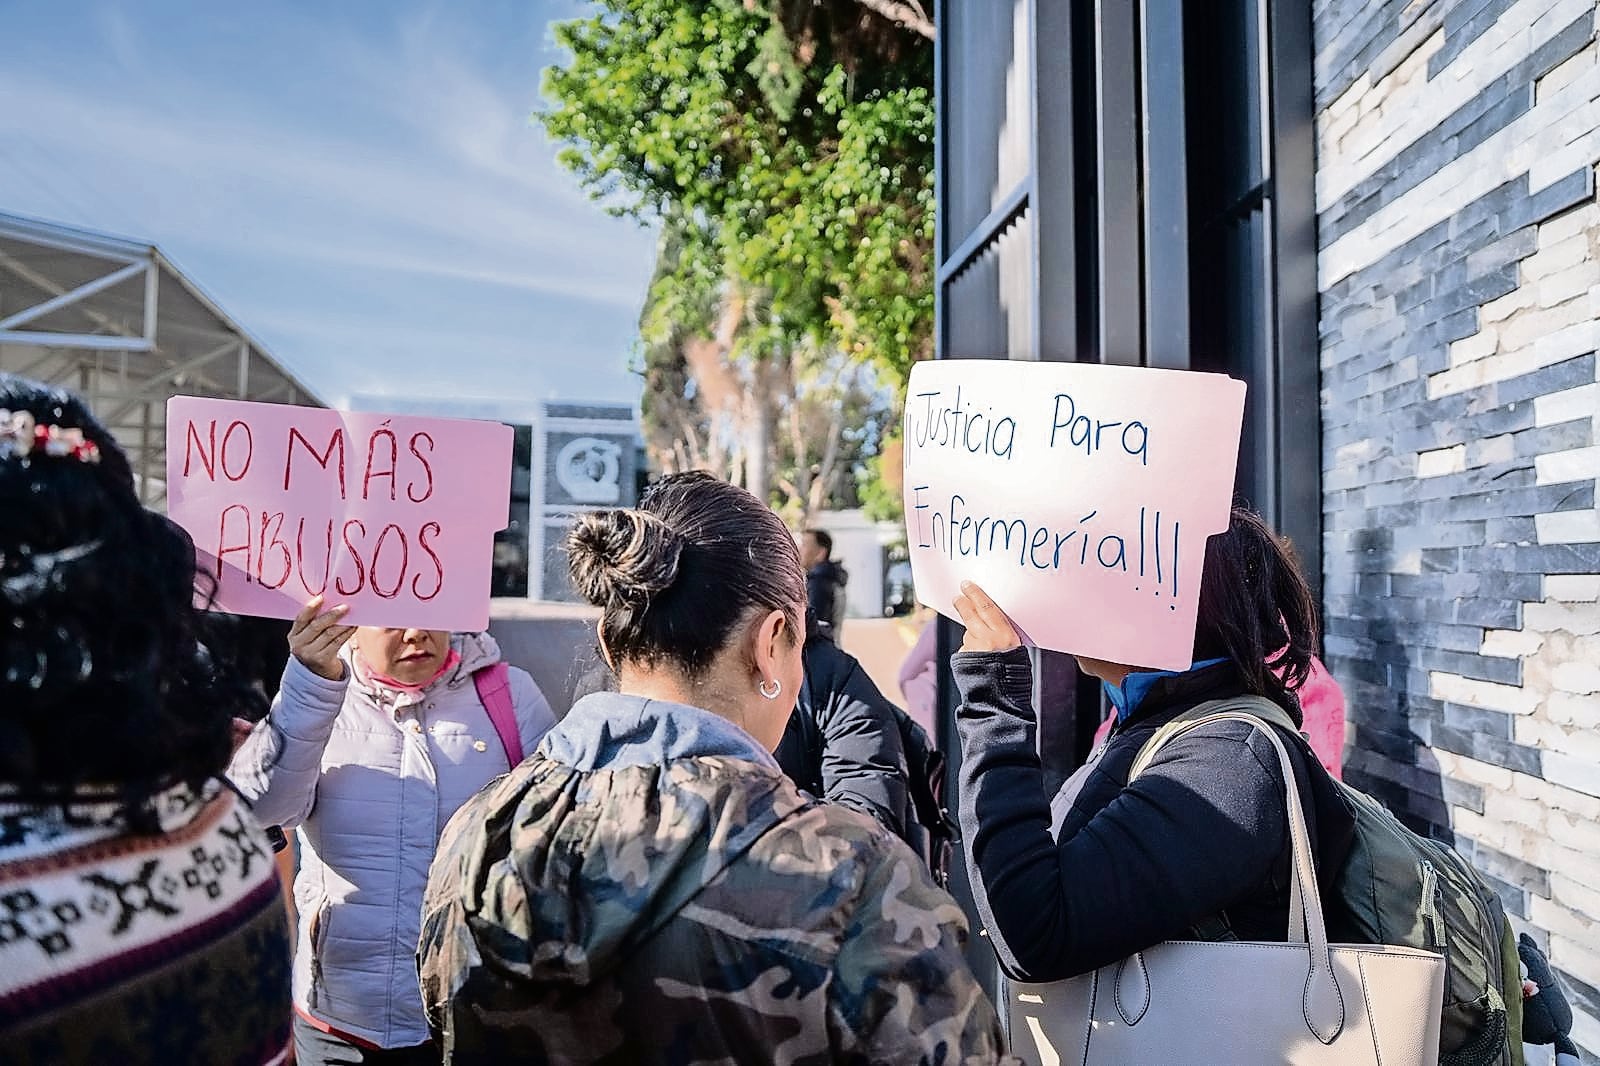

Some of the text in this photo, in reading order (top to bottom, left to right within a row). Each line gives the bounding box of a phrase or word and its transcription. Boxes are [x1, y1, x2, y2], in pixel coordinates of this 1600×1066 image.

[184, 419, 434, 503] NO MÁS
[1050, 394, 1150, 465] Para
[216, 504, 443, 601] ABUSOS
[913, 486, 1180, 610] Enfermería!!!
